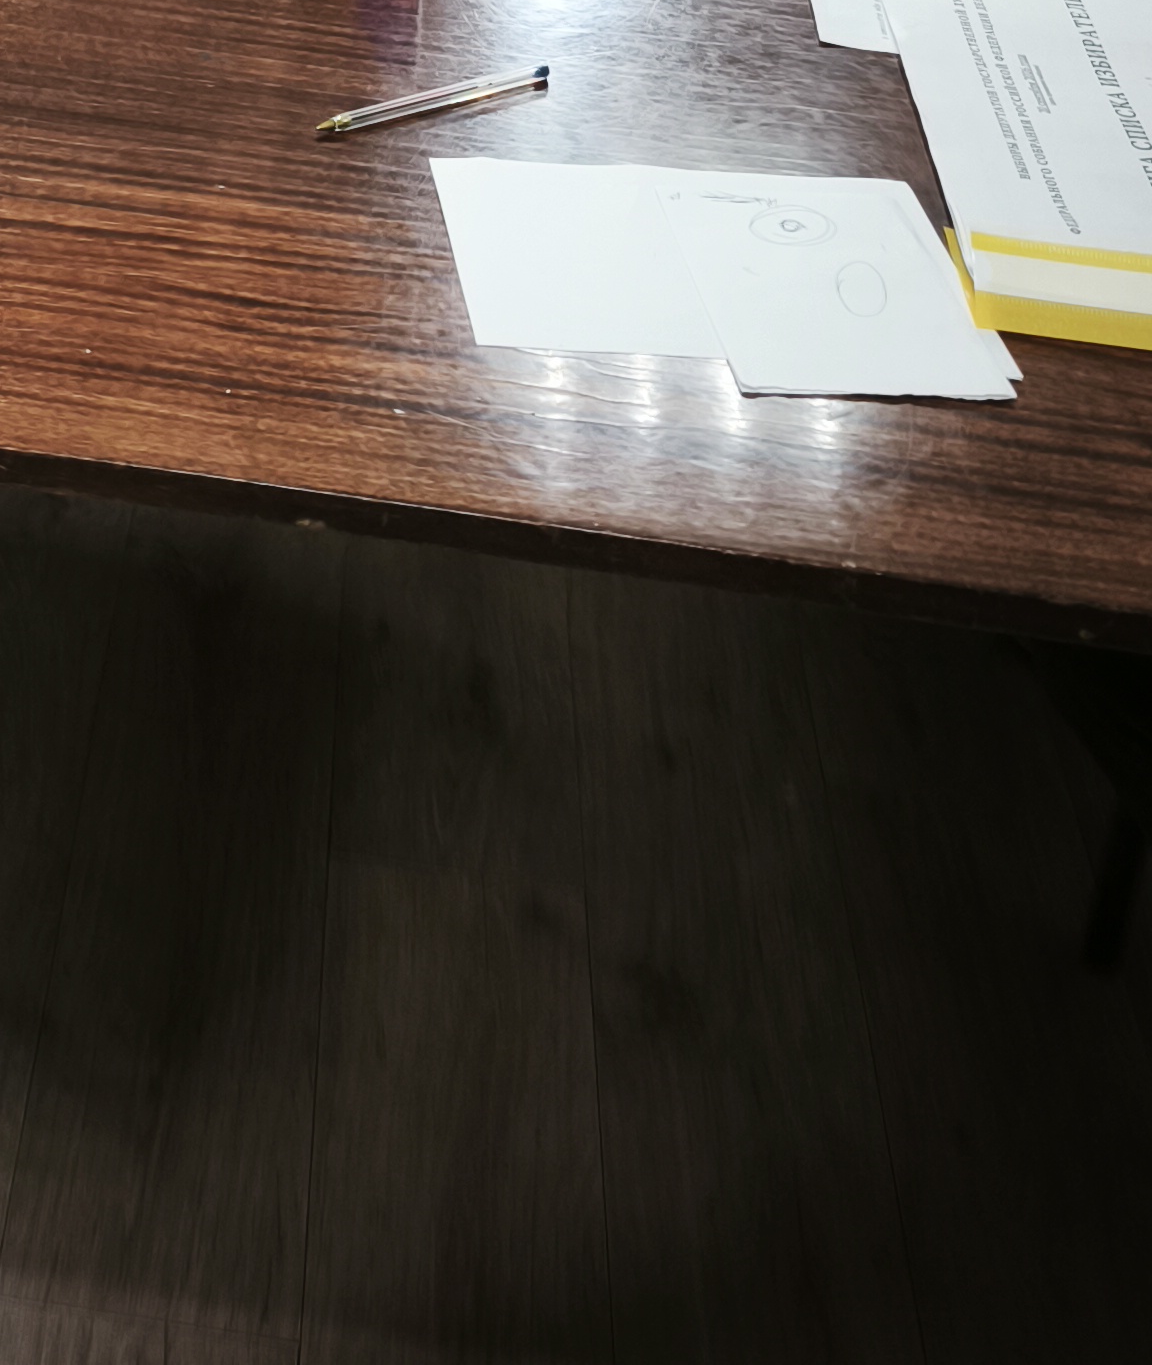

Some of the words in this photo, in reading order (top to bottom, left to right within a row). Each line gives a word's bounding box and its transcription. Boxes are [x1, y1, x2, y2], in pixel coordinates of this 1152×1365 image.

[1020, 119, 1048, 166] СОБРАНИЯ
[1107, 92, 1152, 151] СПИСКА
[1007, 142, 1031, 180] ВЫБОРЫ
